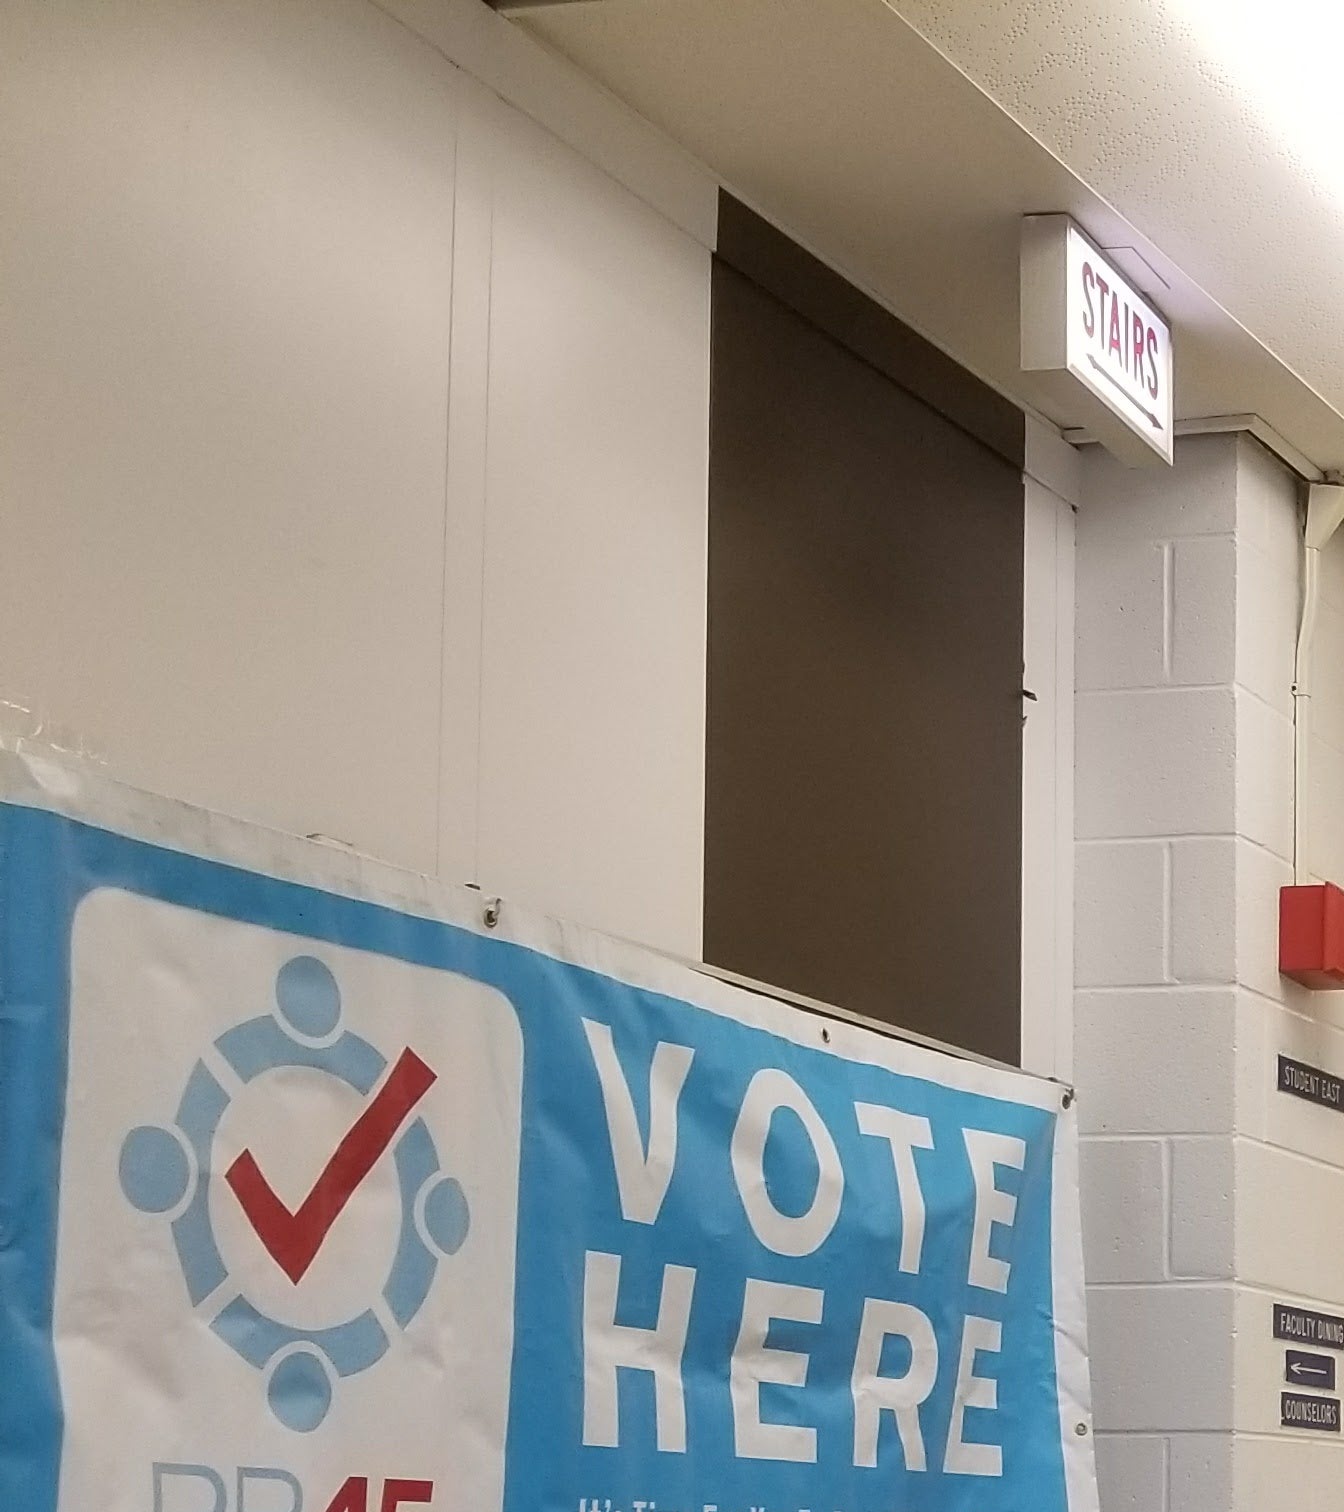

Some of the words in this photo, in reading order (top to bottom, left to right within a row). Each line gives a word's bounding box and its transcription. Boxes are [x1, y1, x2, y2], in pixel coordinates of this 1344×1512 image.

[1082, 261, 1158, 400] STAIRS
[1284, 1065, 1320, 1095] STUDENT
[1321, 1079, 1341, 1105] EAST
[581, 1016, 1026, 1294] VOTE
[581, 1250, 1003, 1477] HERE
[1280, 1312, 1315, 1339] FACULTY
[1285, 1399, 1337, 1425] COUNSELORS
